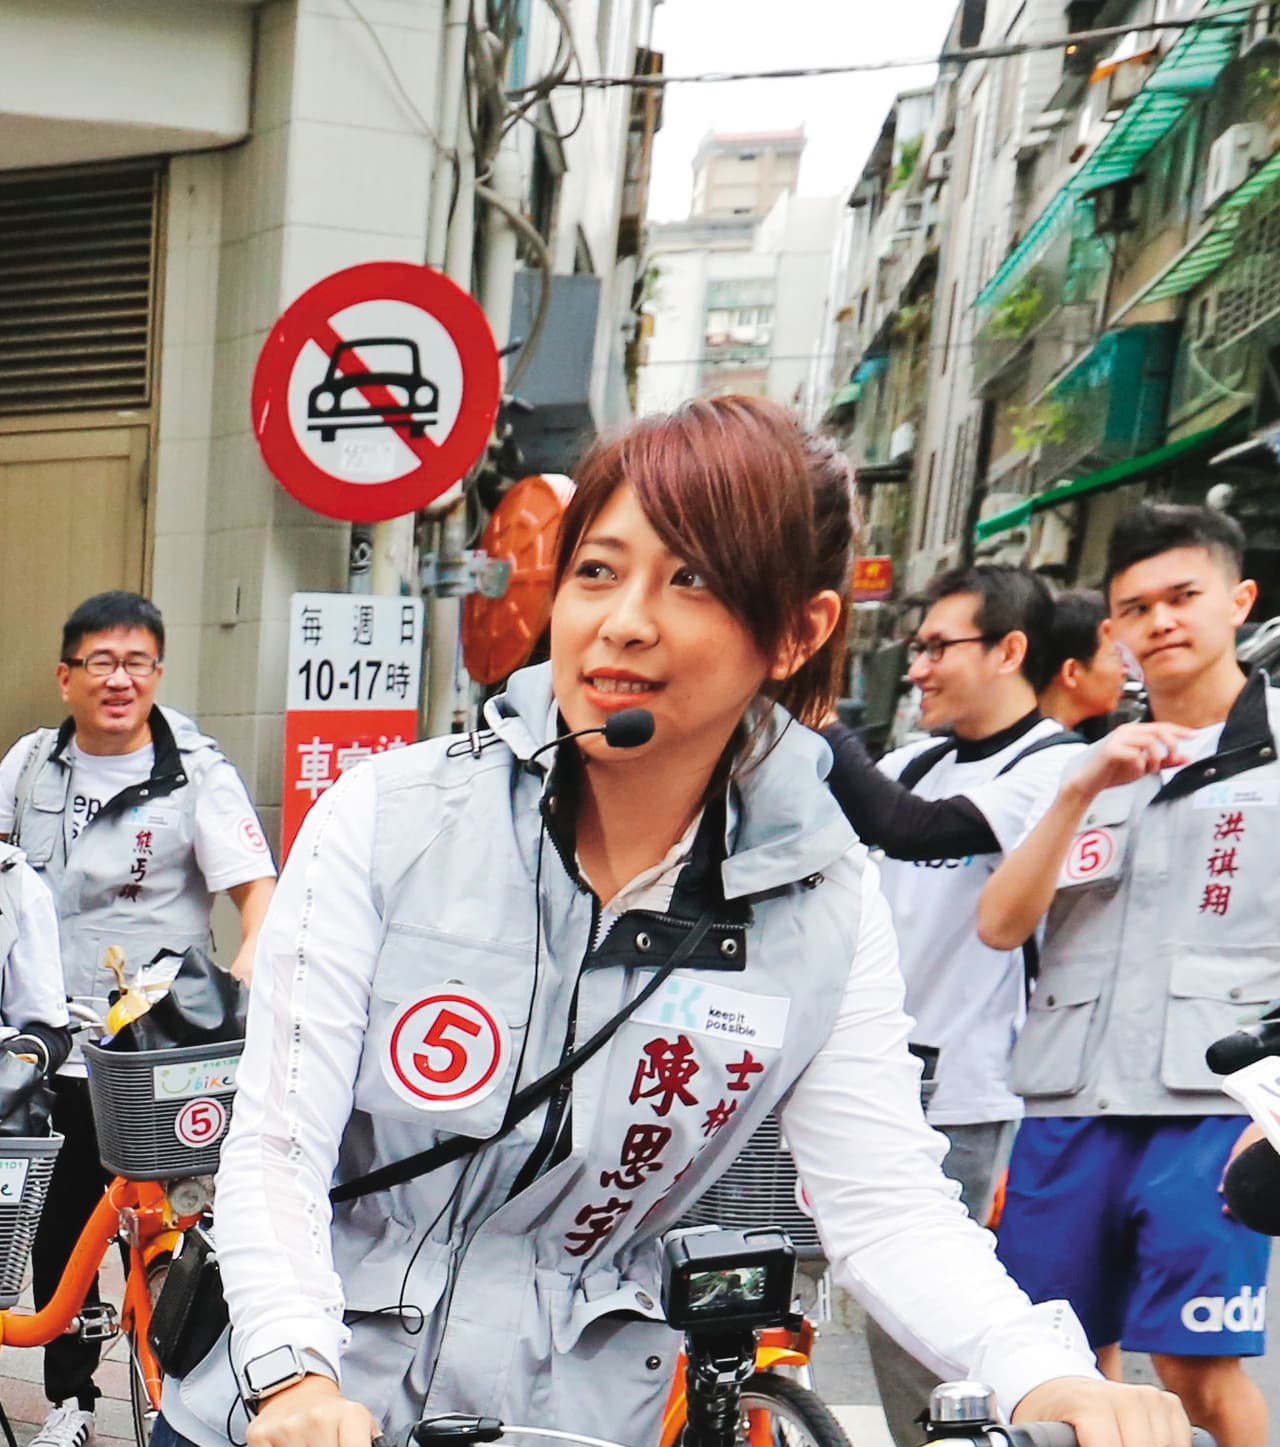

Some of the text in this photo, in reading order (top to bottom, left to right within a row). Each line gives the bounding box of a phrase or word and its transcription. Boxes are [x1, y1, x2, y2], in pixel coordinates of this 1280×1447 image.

[243, 824, 264, 848] 5
[1079, 840, 1100, 872] 5
[413, 1009, 482, 1084] 5
[192, 1108, 212, 1137] 5
